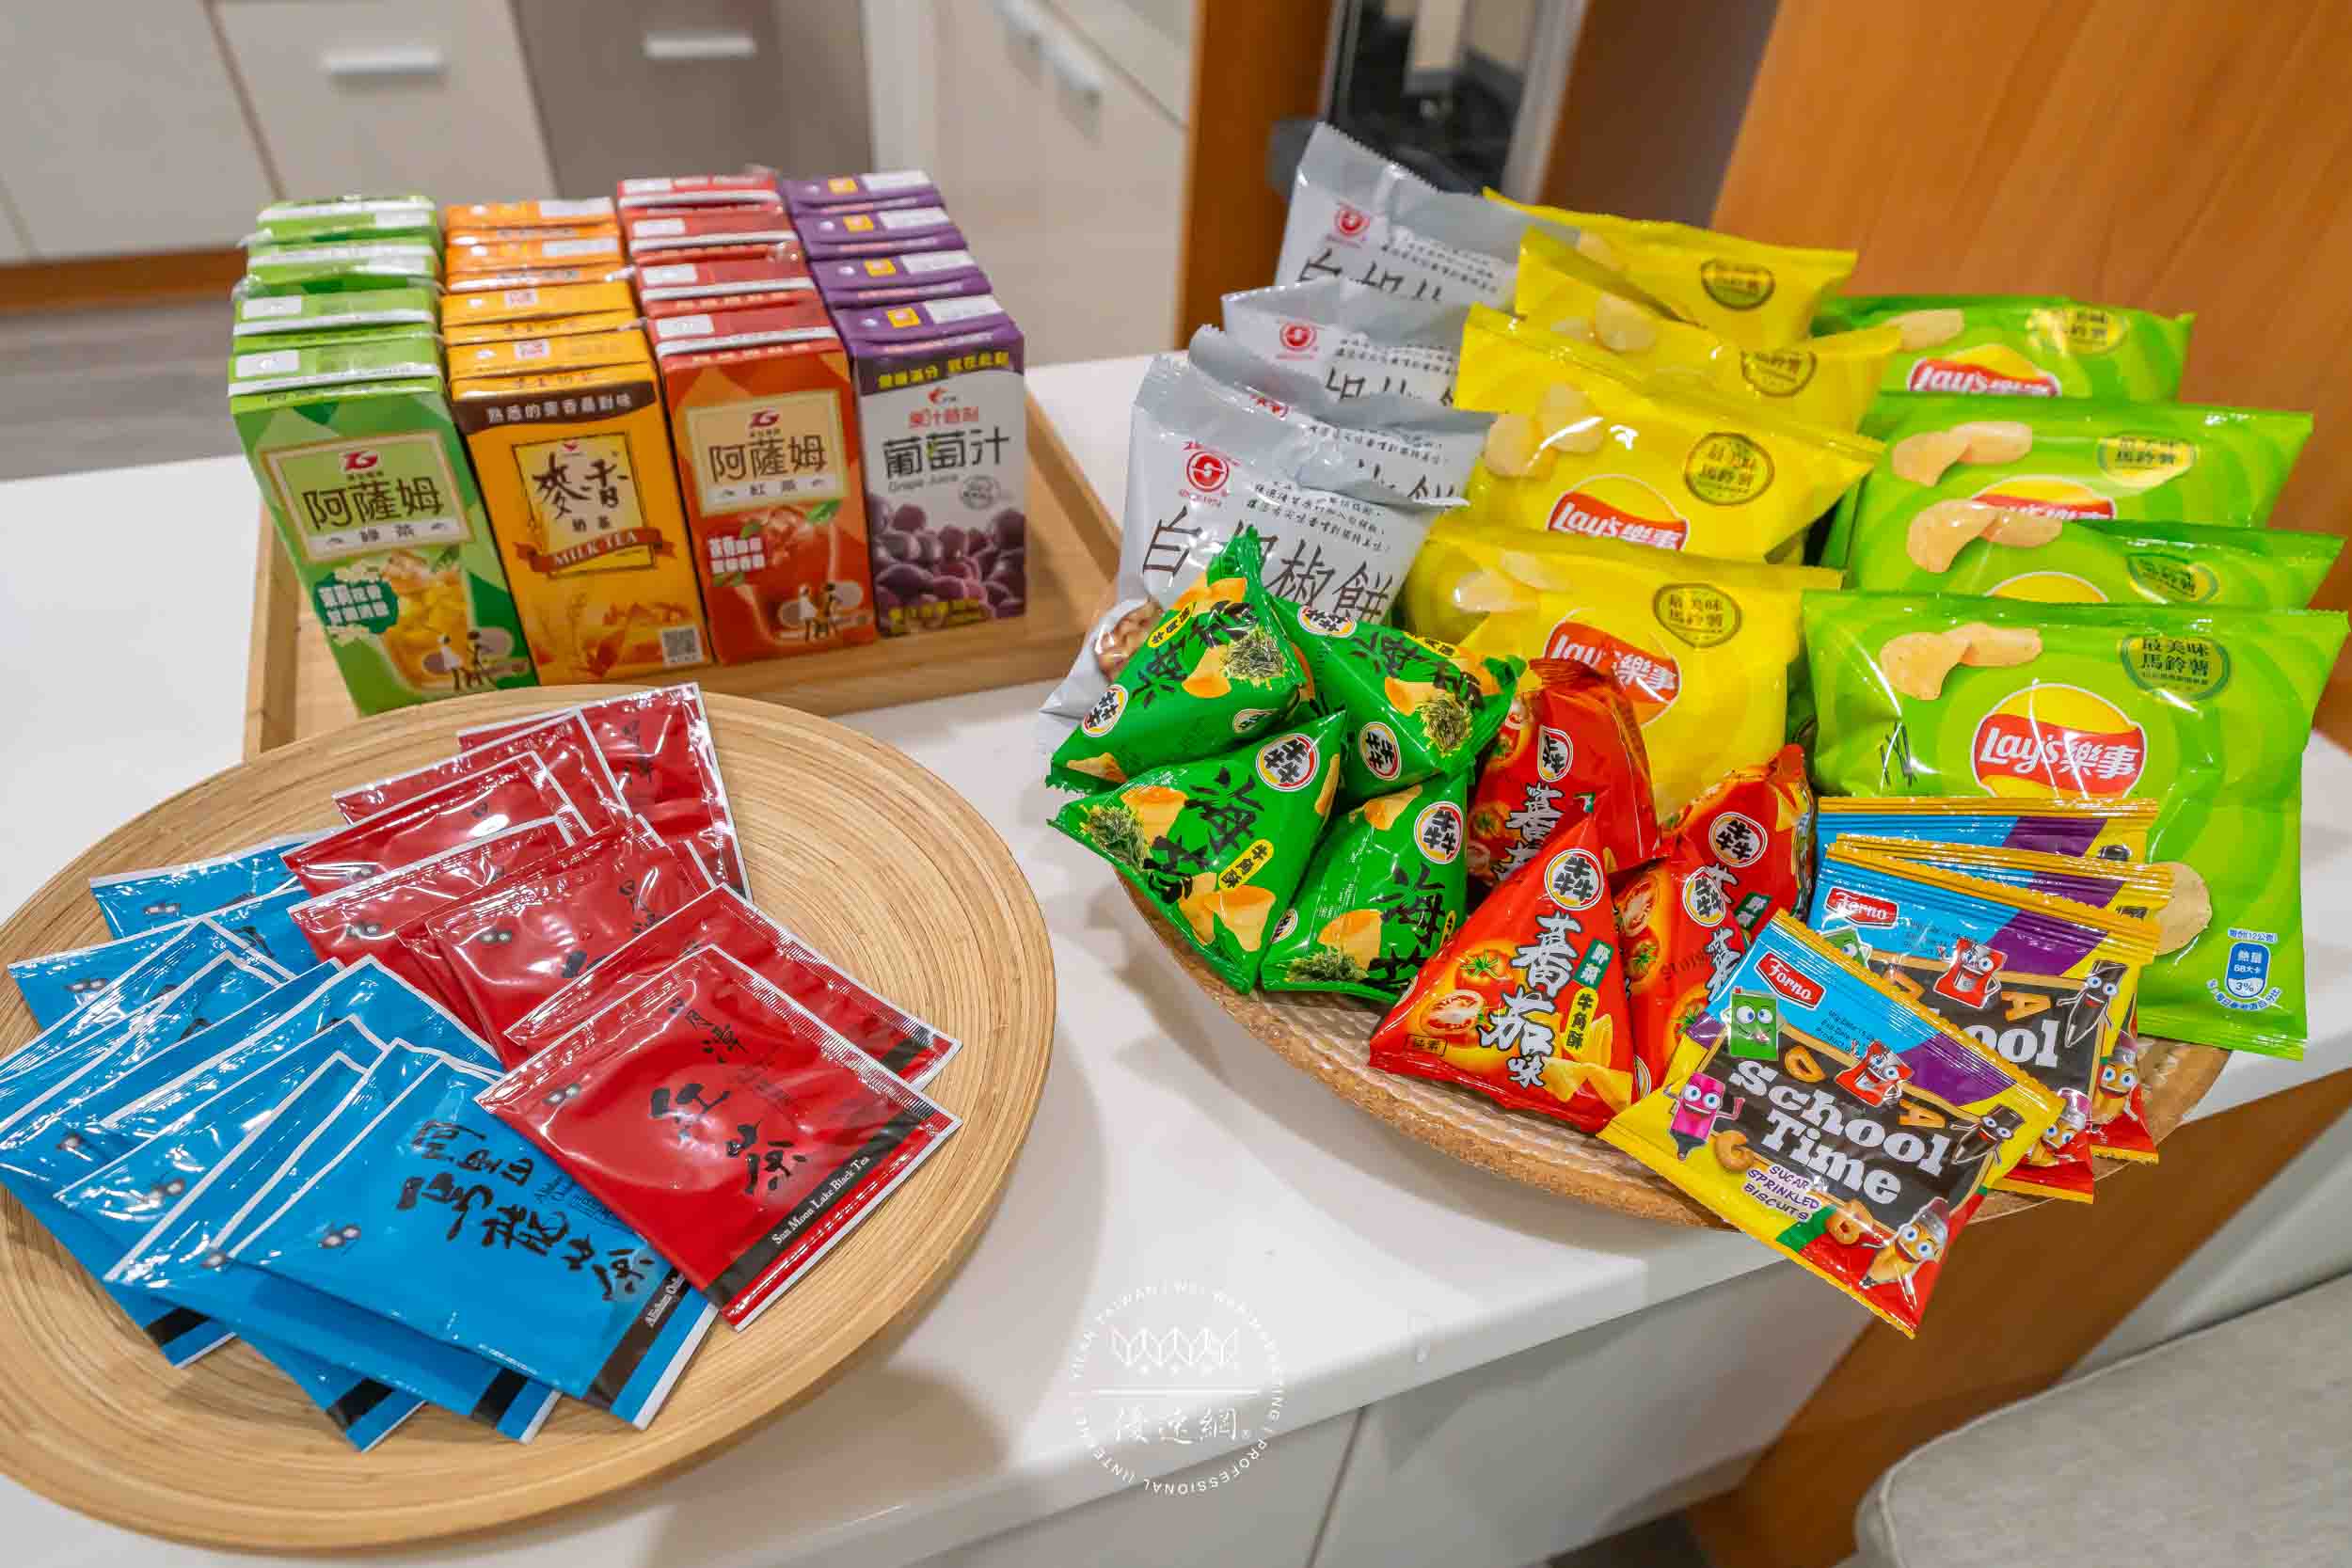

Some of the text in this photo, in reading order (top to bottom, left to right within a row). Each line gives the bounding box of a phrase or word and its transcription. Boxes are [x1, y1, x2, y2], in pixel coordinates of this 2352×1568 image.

[707, 435, 826, 483] 阿薩姆
[882, 426, 1010, 480] 葡萄汁
[302, 476, 445, 531] 阿薩姆
[1142, 505, 1392, 623] 白椒餅
[2139, 654, 2212, 676] 馬鈴薯
[2141, 637, 2211, 657] 最美味
[1979, 727, 2063, 774] Lay's
[2058, 739, 2140, 780] 樂事
[1768, 957, 1814, 1001] Forno
[2235, 981, 2255, 993] 3%
[1728, 1060, 1950, 1177] School
[1761, 1108, 1901, 1205] Time
[1769, 1165, 1810, 1191] SUGAR
[771, 1151, 871, 1246] Sun Moon Lake Black Tea
[1743, 1182, 1809, 1220] BISCUITS
[1747, 1168, 1820, 1210] SPRINKLED
